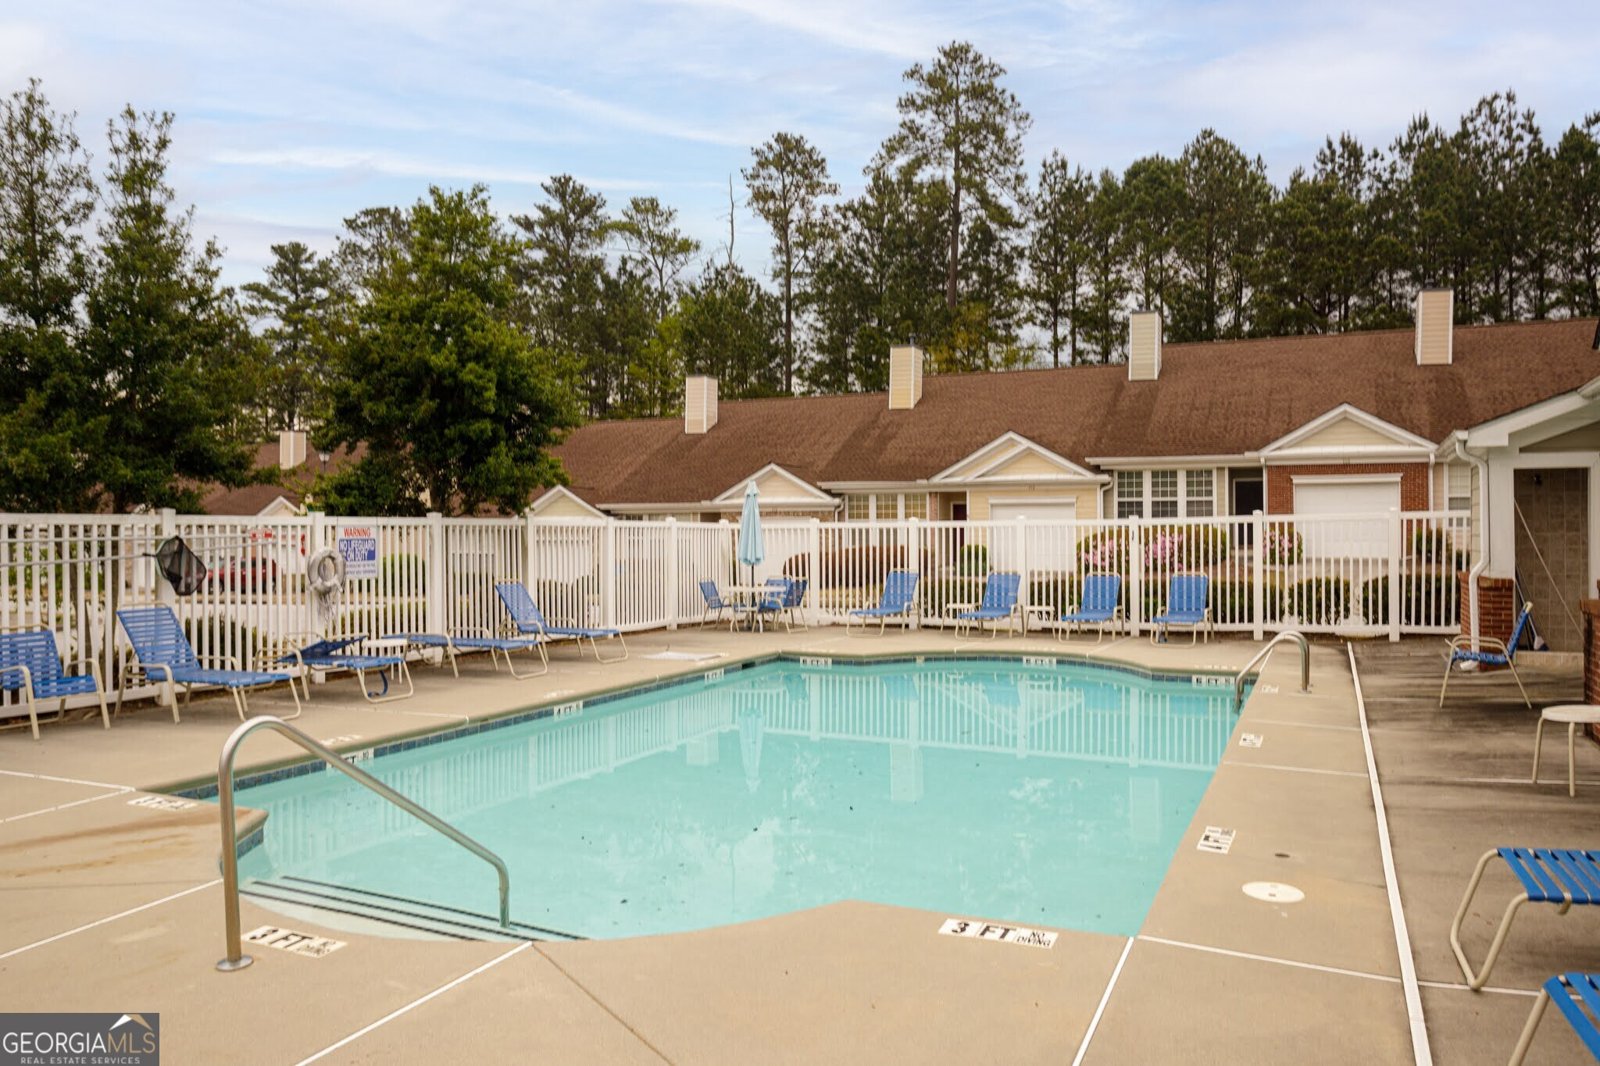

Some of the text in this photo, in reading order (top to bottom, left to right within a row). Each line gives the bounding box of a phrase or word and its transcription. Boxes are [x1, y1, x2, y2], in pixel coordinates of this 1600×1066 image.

[344, 527, 371, 537] WARNING
[339, 540, 375, 551] NO LIFEGUARD
[347, 549, 368, 561] ON DUTY
[950, 922, 1017, 940] 3 FT
[1031, 931, 1046, 939] NO
[269, 932, 314, 949] FT
[1017, 936, 1051, 947] DIVING
